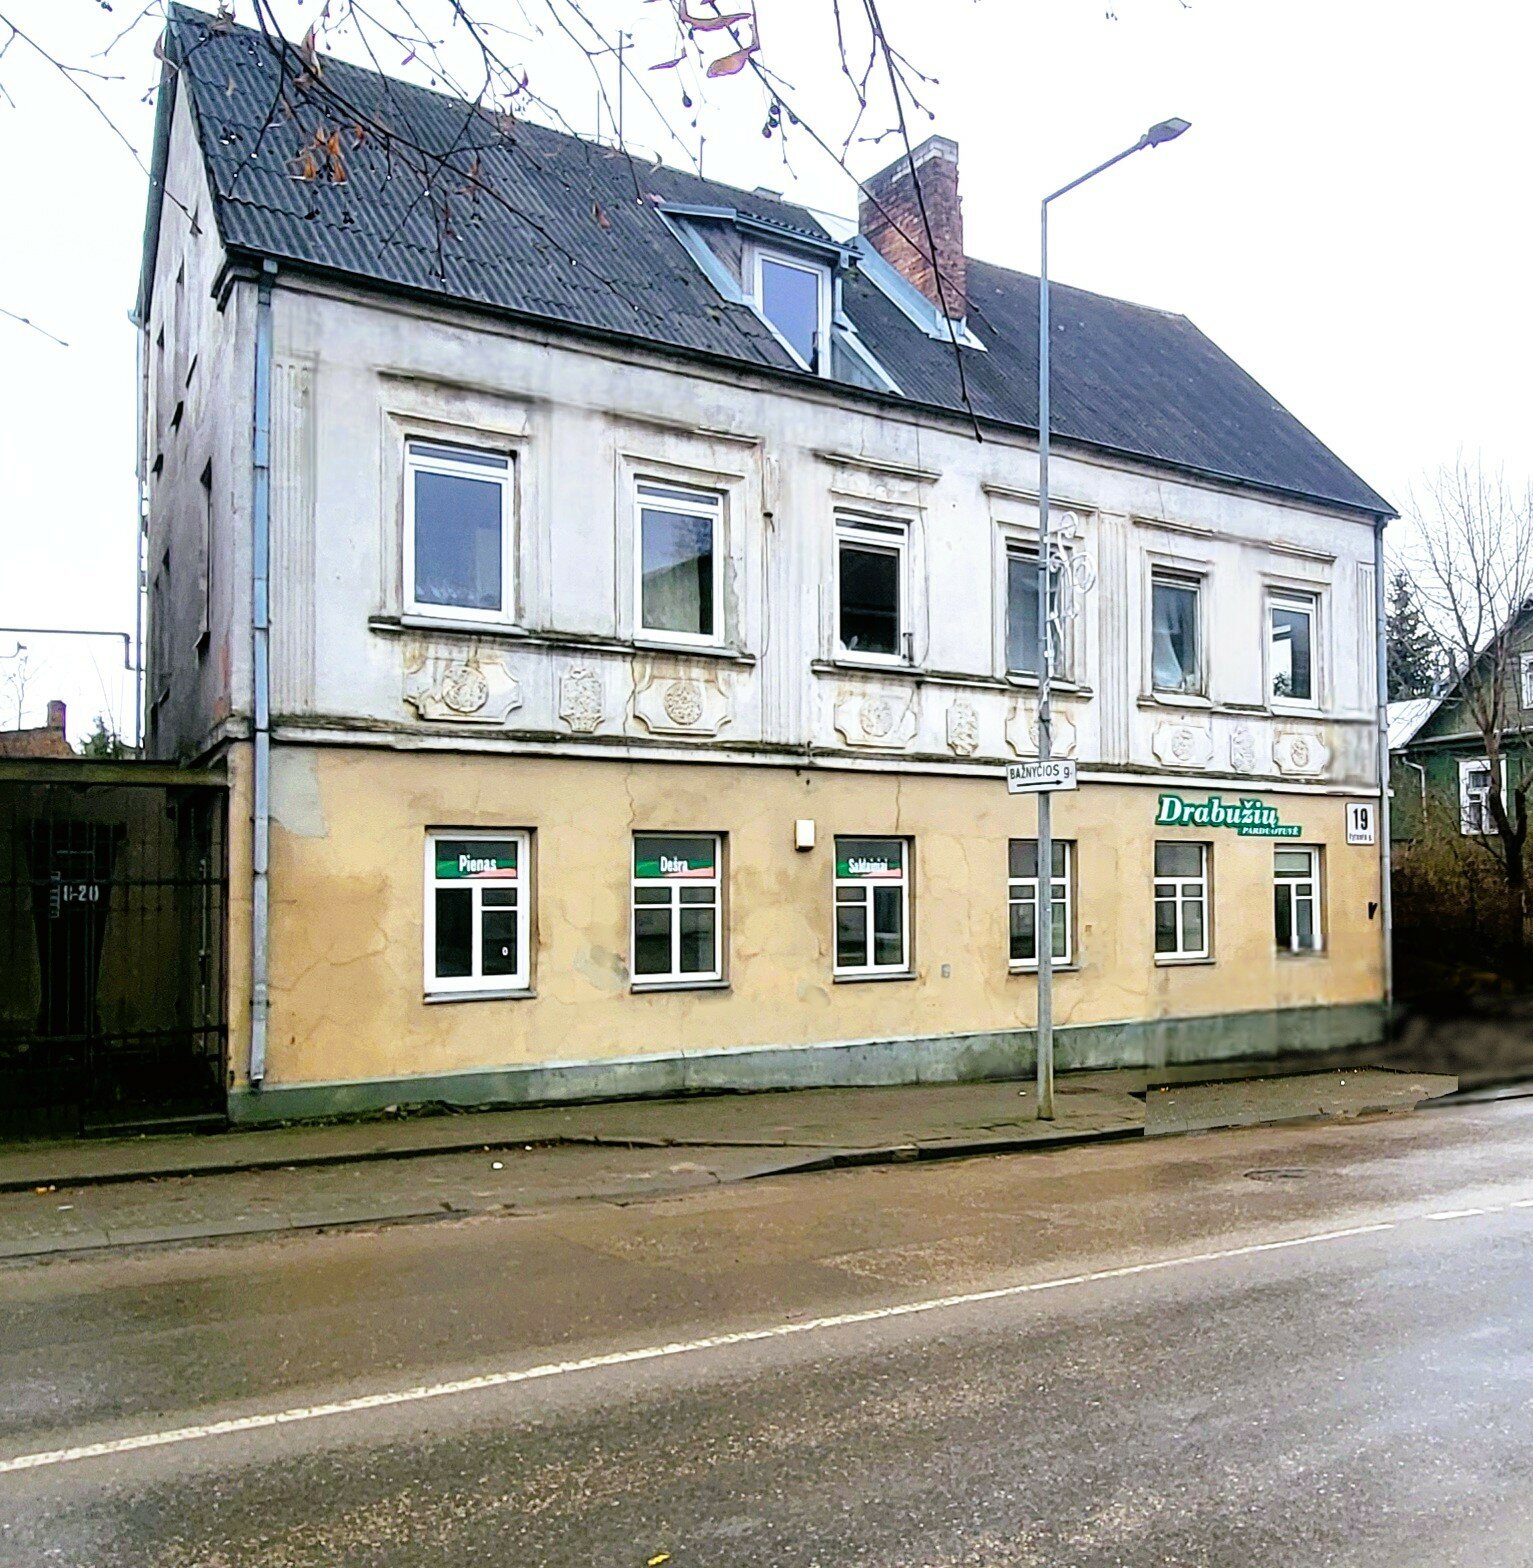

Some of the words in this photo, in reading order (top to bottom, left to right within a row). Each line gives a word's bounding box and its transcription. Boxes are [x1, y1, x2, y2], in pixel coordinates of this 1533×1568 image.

[1157, 796, 1277, 828] Drabužių
[1353, 807, 1368, 831] 19
[458, 853, 498, 872] Pienas
